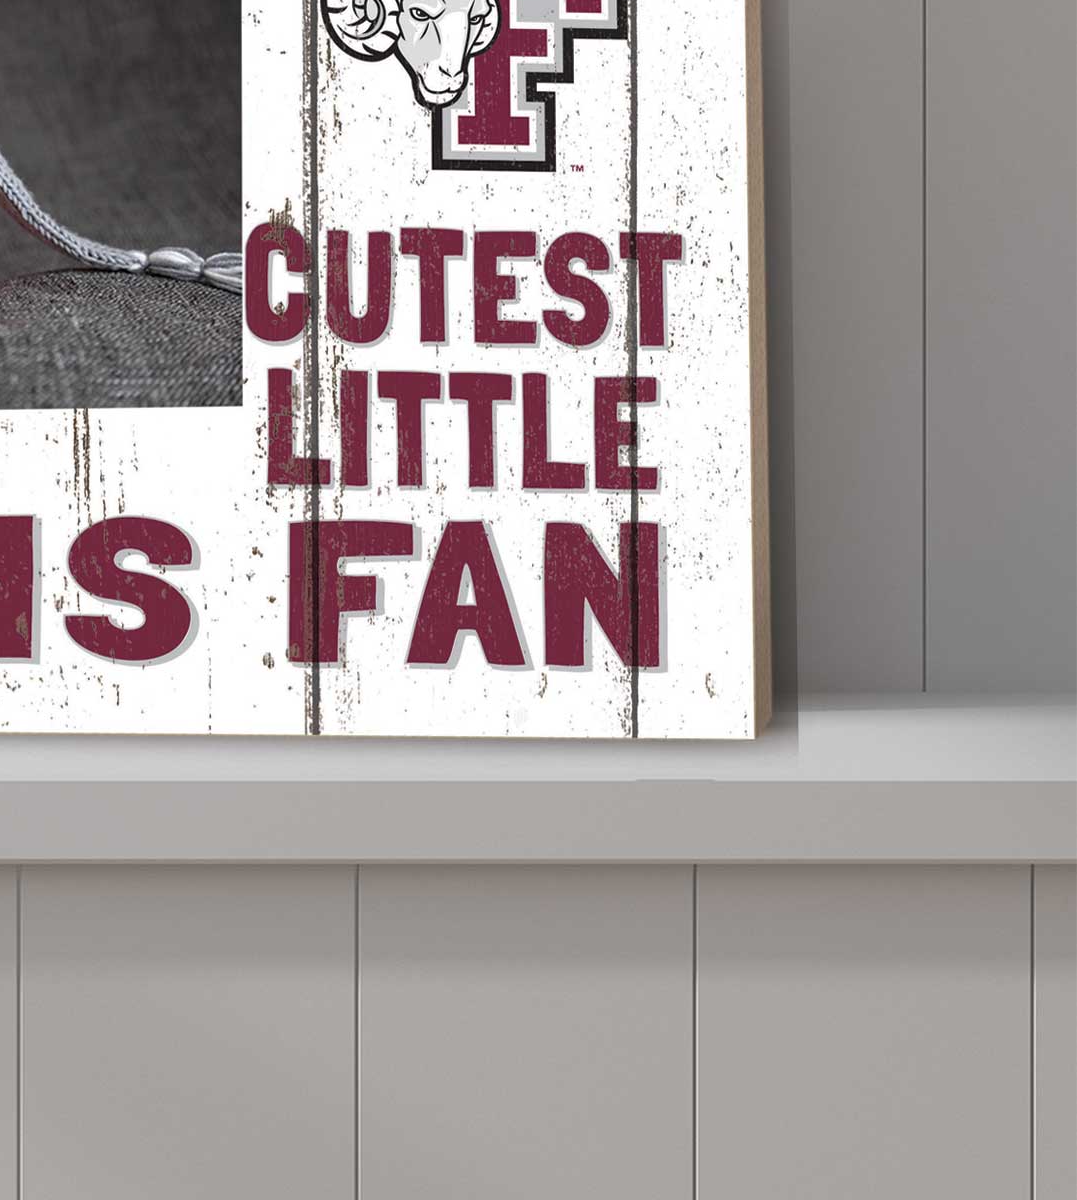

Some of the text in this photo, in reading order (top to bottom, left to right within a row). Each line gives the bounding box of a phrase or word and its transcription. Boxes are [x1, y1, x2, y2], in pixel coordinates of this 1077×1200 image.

[570, 164, 585, 172] TM
[244, 222, 685, 349] CUTEST
[267, 367, 662, 493] LITTLE
[288, 519, 668, 673] FAN
